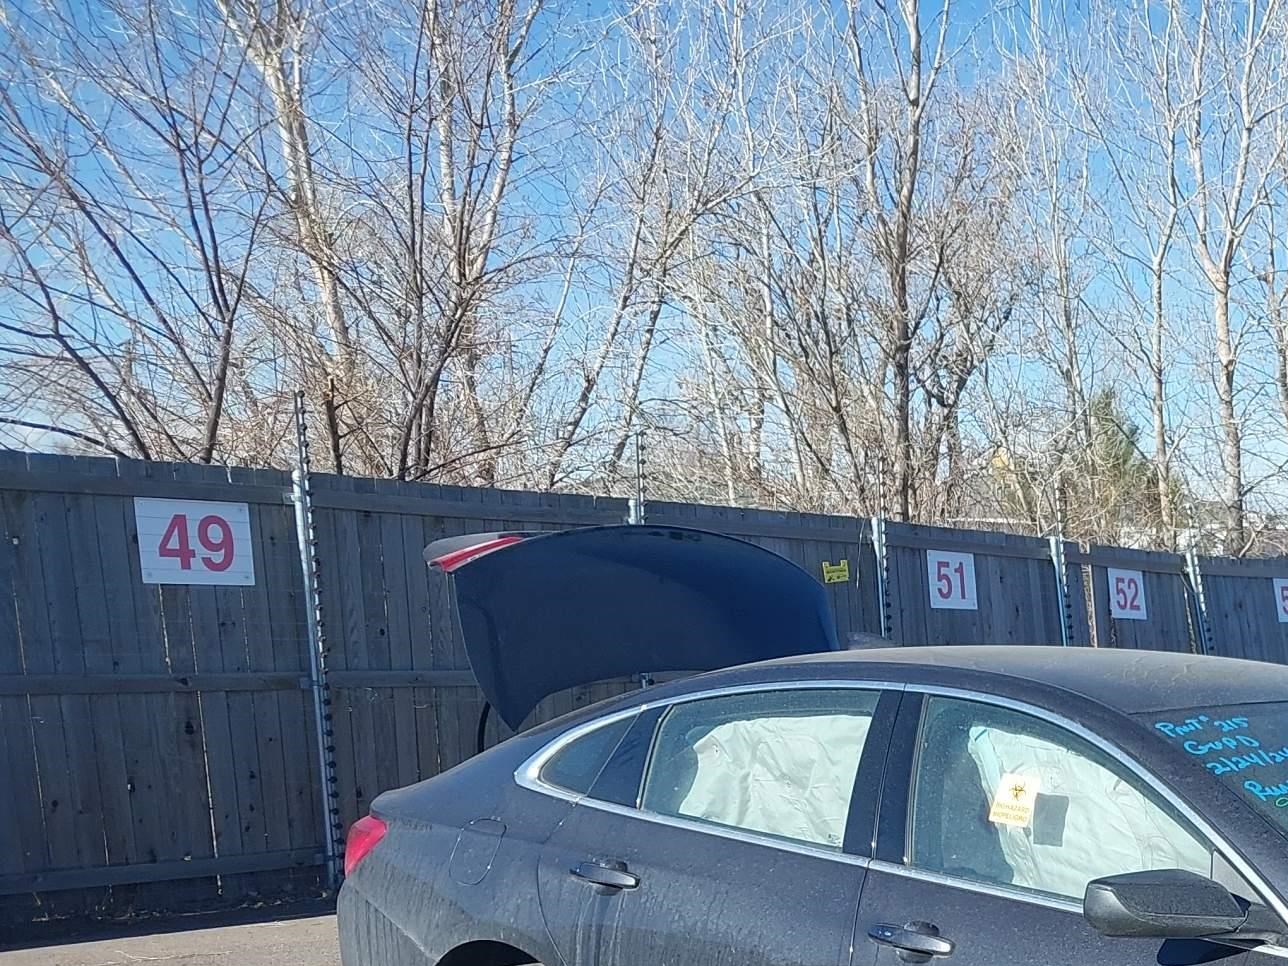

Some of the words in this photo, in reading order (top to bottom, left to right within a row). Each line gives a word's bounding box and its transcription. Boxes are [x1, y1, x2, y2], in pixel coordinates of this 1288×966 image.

[157, 513, 235, 572] 49
[936, 560, 967, 600] 51
[1114, 576, 1141, 611] 52
